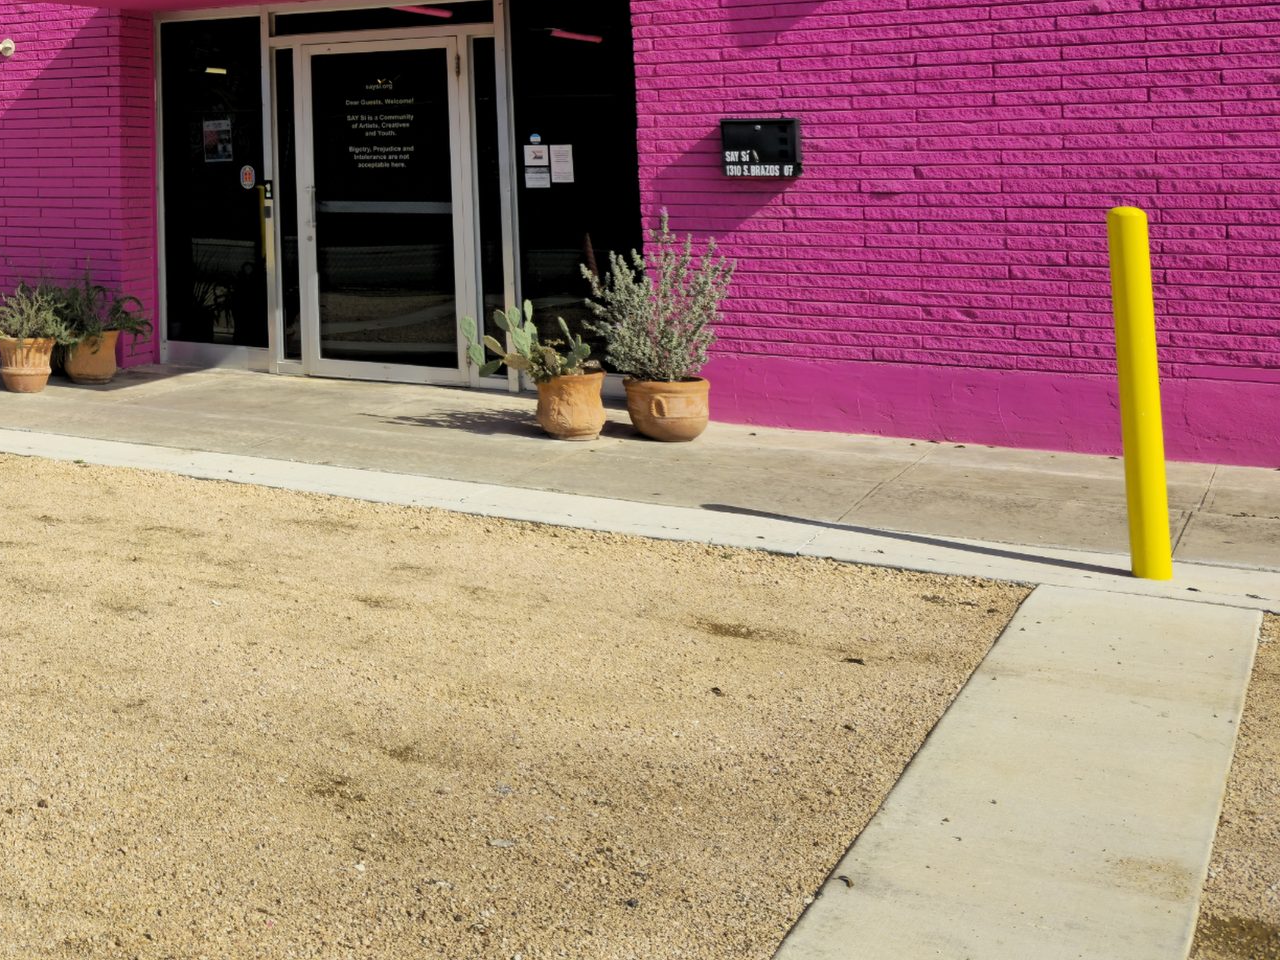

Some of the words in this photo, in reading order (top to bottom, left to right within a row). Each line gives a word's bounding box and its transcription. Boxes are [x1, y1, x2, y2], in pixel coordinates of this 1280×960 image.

[384, 97, 414, 105] Welcome!
[379, 113, 414, 121] Community
[381, 121, 410, 129] Creatives
[372, 145, 401, 153] Prejudice
[725, 151, 739, 162] SAY
[740, 150, 751, 162] Sí
[358, 161, 390, 169] acceptable
[726, 165, 742, 176] 1310
